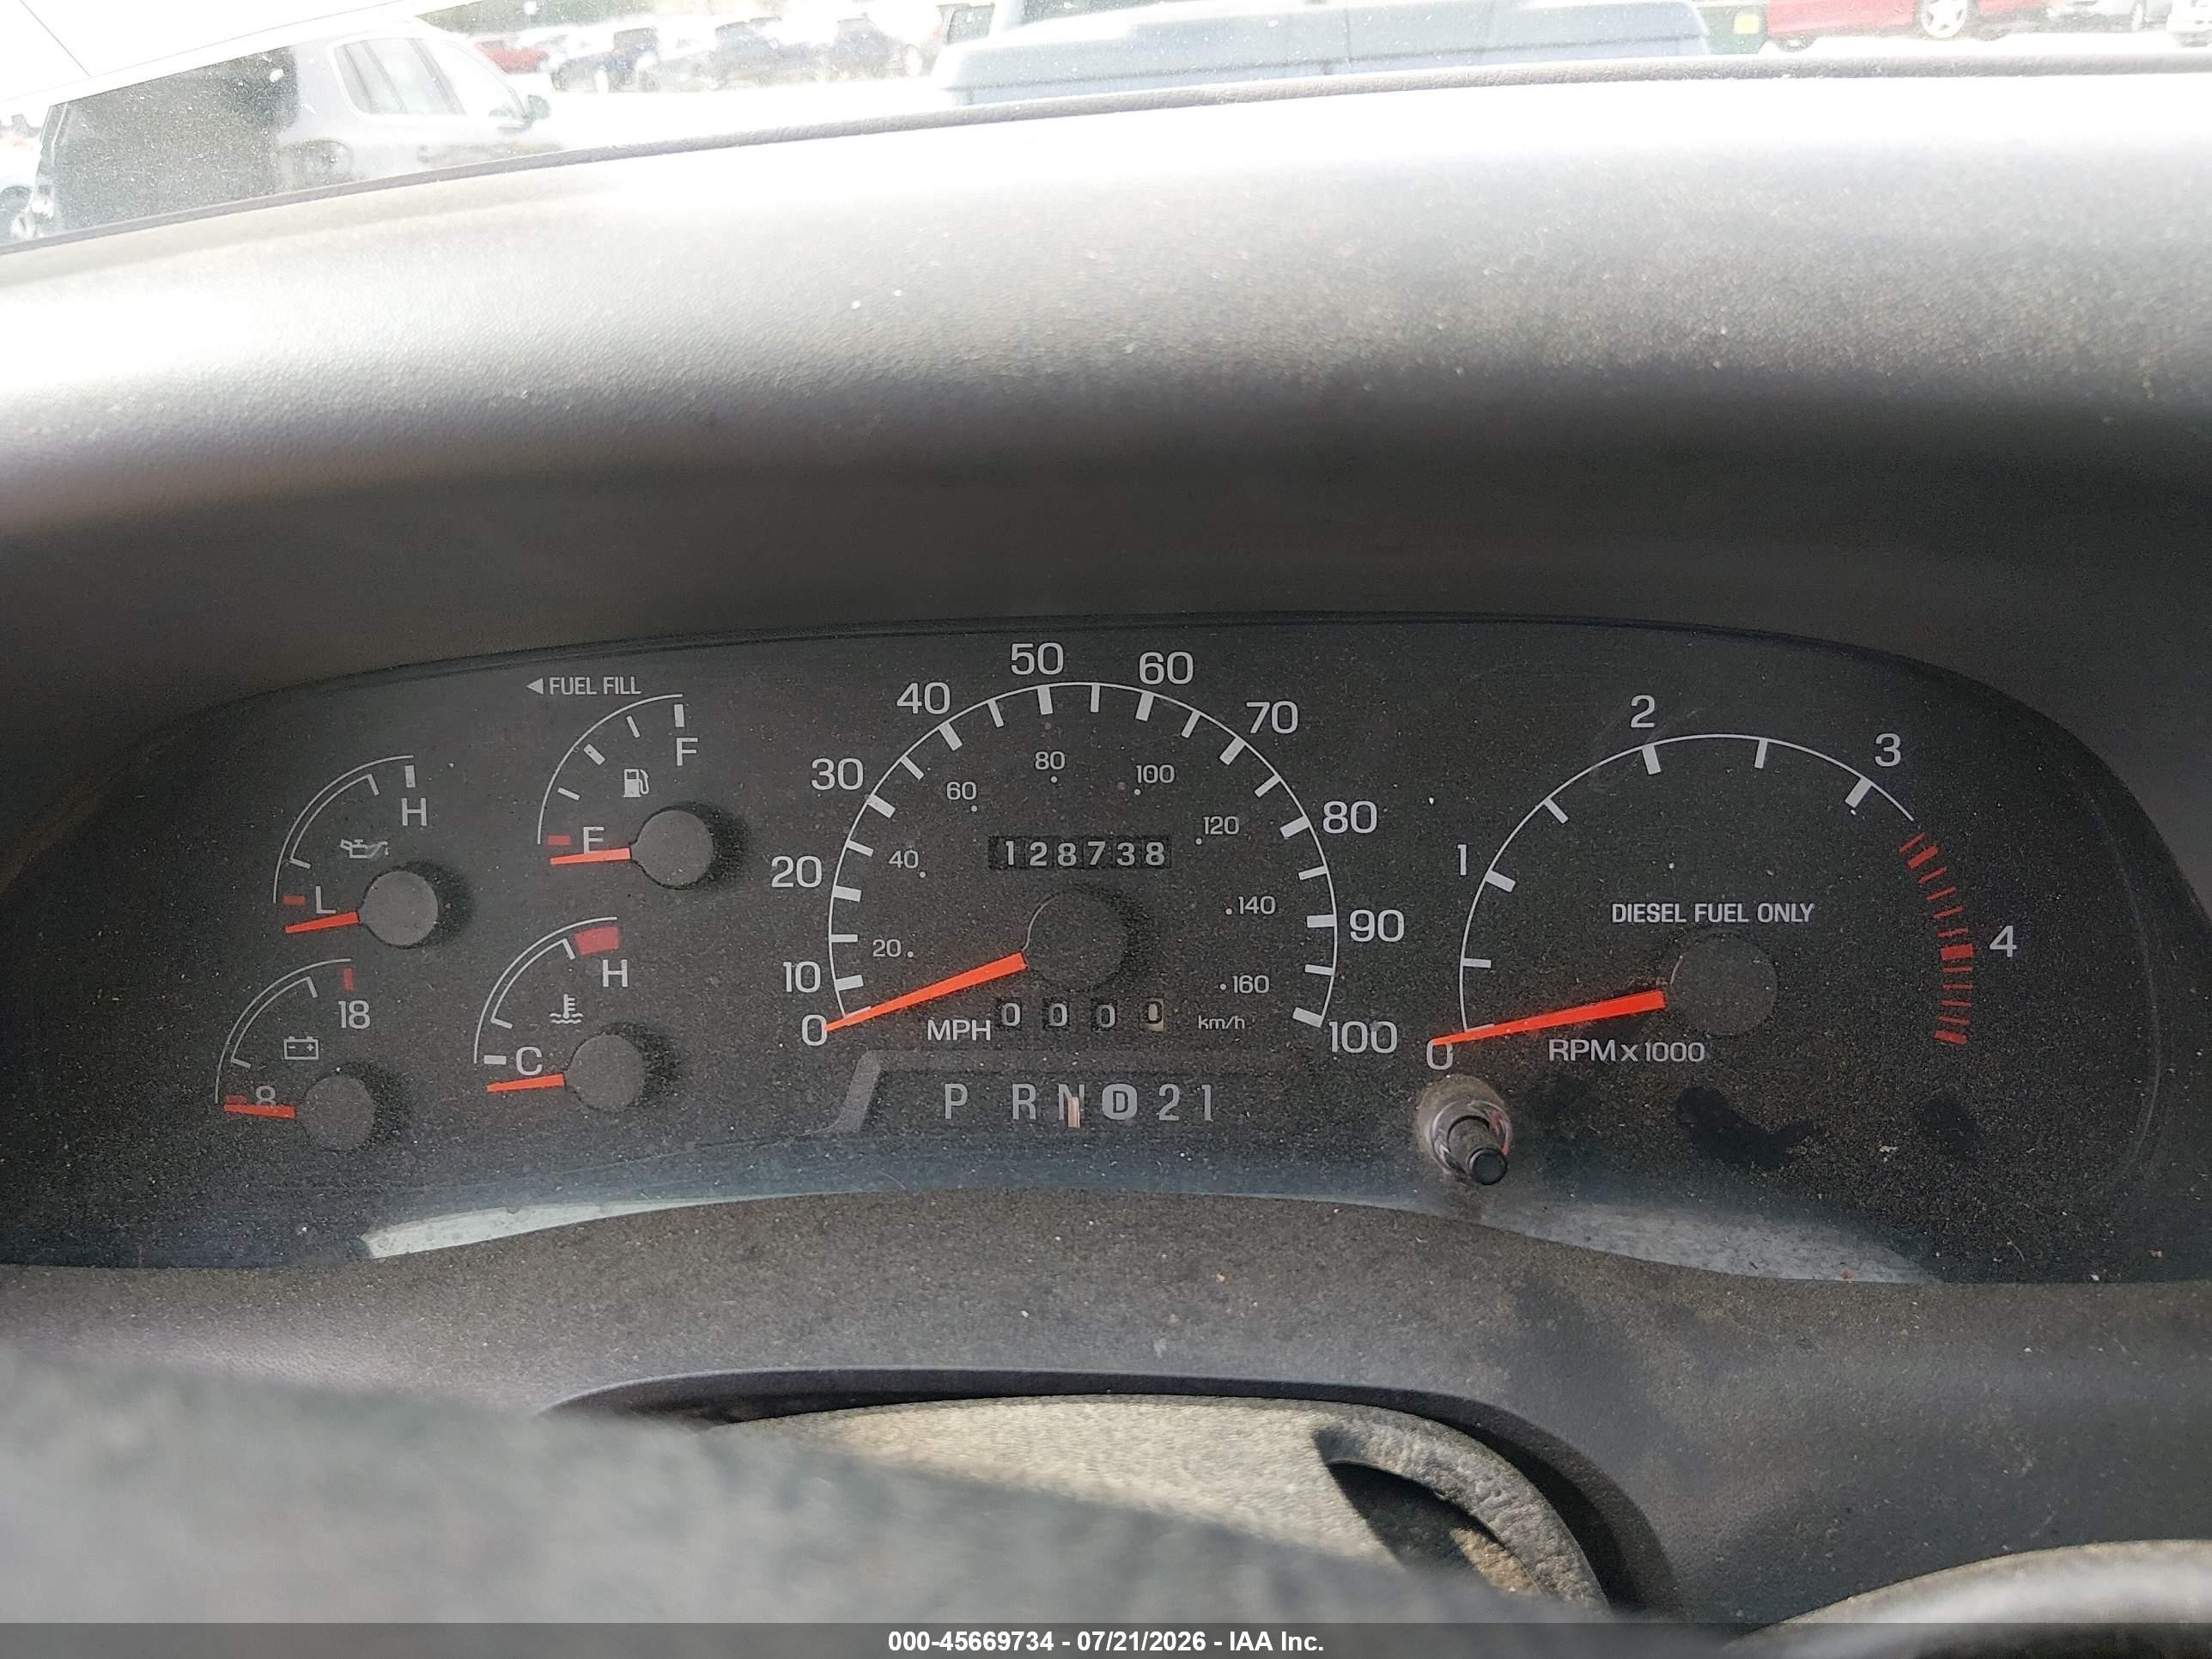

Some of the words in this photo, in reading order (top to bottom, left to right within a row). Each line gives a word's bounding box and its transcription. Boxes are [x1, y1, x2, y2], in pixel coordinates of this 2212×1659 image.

[1010, 643, 1064, 675] 50
[1139, 652, 1194, 684] 60
[550, 678, 597, 695] FUEL
[603, 677, 641, 695] FILL
[896, 682, 950, 714] 40
[1246, 701, 1298, 733] 70
[1630, 696, 1656, 728] 2
[676, 737, 698, 766] F
[1034, 751, 1066, 771] 80
[1875, 733, 1902, 767] 3
[811, 757, 864, 789] 30
[1135, 764, 1175, 783] 100
[946, 781, 977, 801] 60
[401, 798, 427, 826] H
[1203, 816, 1239, 835] 120
[1323, 801, 1377, 834] 80
[582, 826, 605, 854] E
[1006, 841, 1164, 866] 128738
[771, 856, 823, 888] 20
[888, 850, 919, 868] 40
[1457, 844, 1468, 875] 1
[315, 885, 336, 914] L
[1237, 896, 1275, 915] 140
[1612, 903, 1686, 923] DIESEL
[1694, 903, 1751, 923] FUEL
[1758, 903, 1814, 924] ONLY
[1349, 909, 1405, 942] 90
[872, 939, 902, 957] 20
[1990, 928, 2017, 957] 4
[602, 959, 629, 988] H
[783, 962, 820, 993] 10
[1231, 975, 1269, 994] 160
[338, 1000, 370, 1030] 18
[1198, 1014, 1245, 1030] km/h
[802, 1015, 827, 1046] 0
[927, 1020, 991, 1041] MPH
[1329, 1022, 1398, 1054] 100
[515, 1046, 543, 1076] C
[1426, 1038, 1453, 1071] 0
[1548, 1040, 1617, 1062] RPM
[1644, 1041, 1705, 1062] 1000
[945, 1084, 969, 1118] P
[1012, 1084, 1036, 1118] R
[1058, 1083, 1084, 1120] N
[1158, 1084, 1182, 1120] 2
[1201, 1084, 1212, 1121] 1
